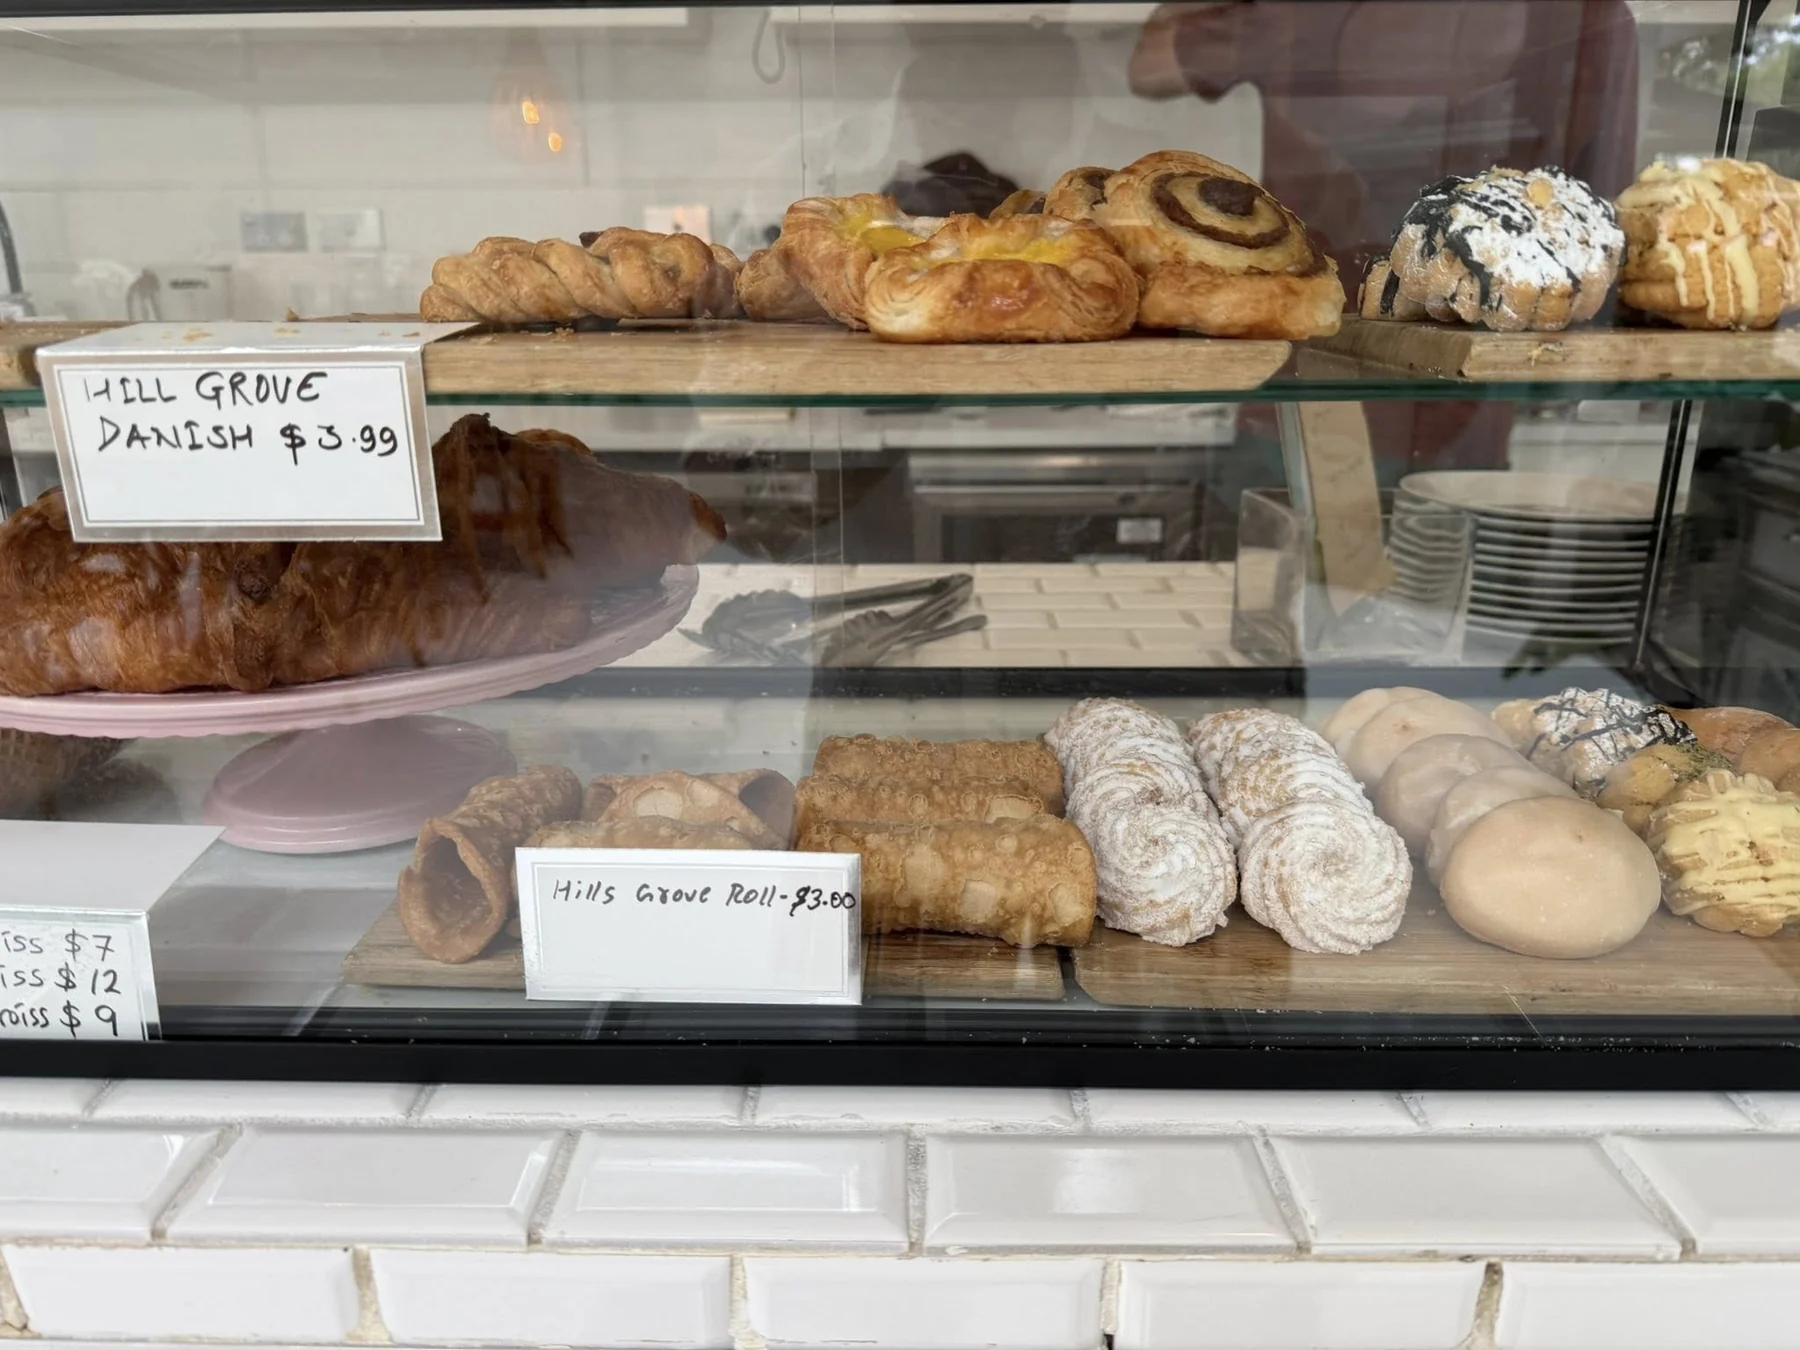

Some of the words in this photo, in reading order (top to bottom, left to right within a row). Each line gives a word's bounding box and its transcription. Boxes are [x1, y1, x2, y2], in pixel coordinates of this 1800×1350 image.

[84, 376, 177, 403] HILL
[195, 371, 328, 410] GROVE
[98, 416, 253, 452] DANISH
[552, 879, 615, 905] Hills
[636, 882, 712, 905] Grove
